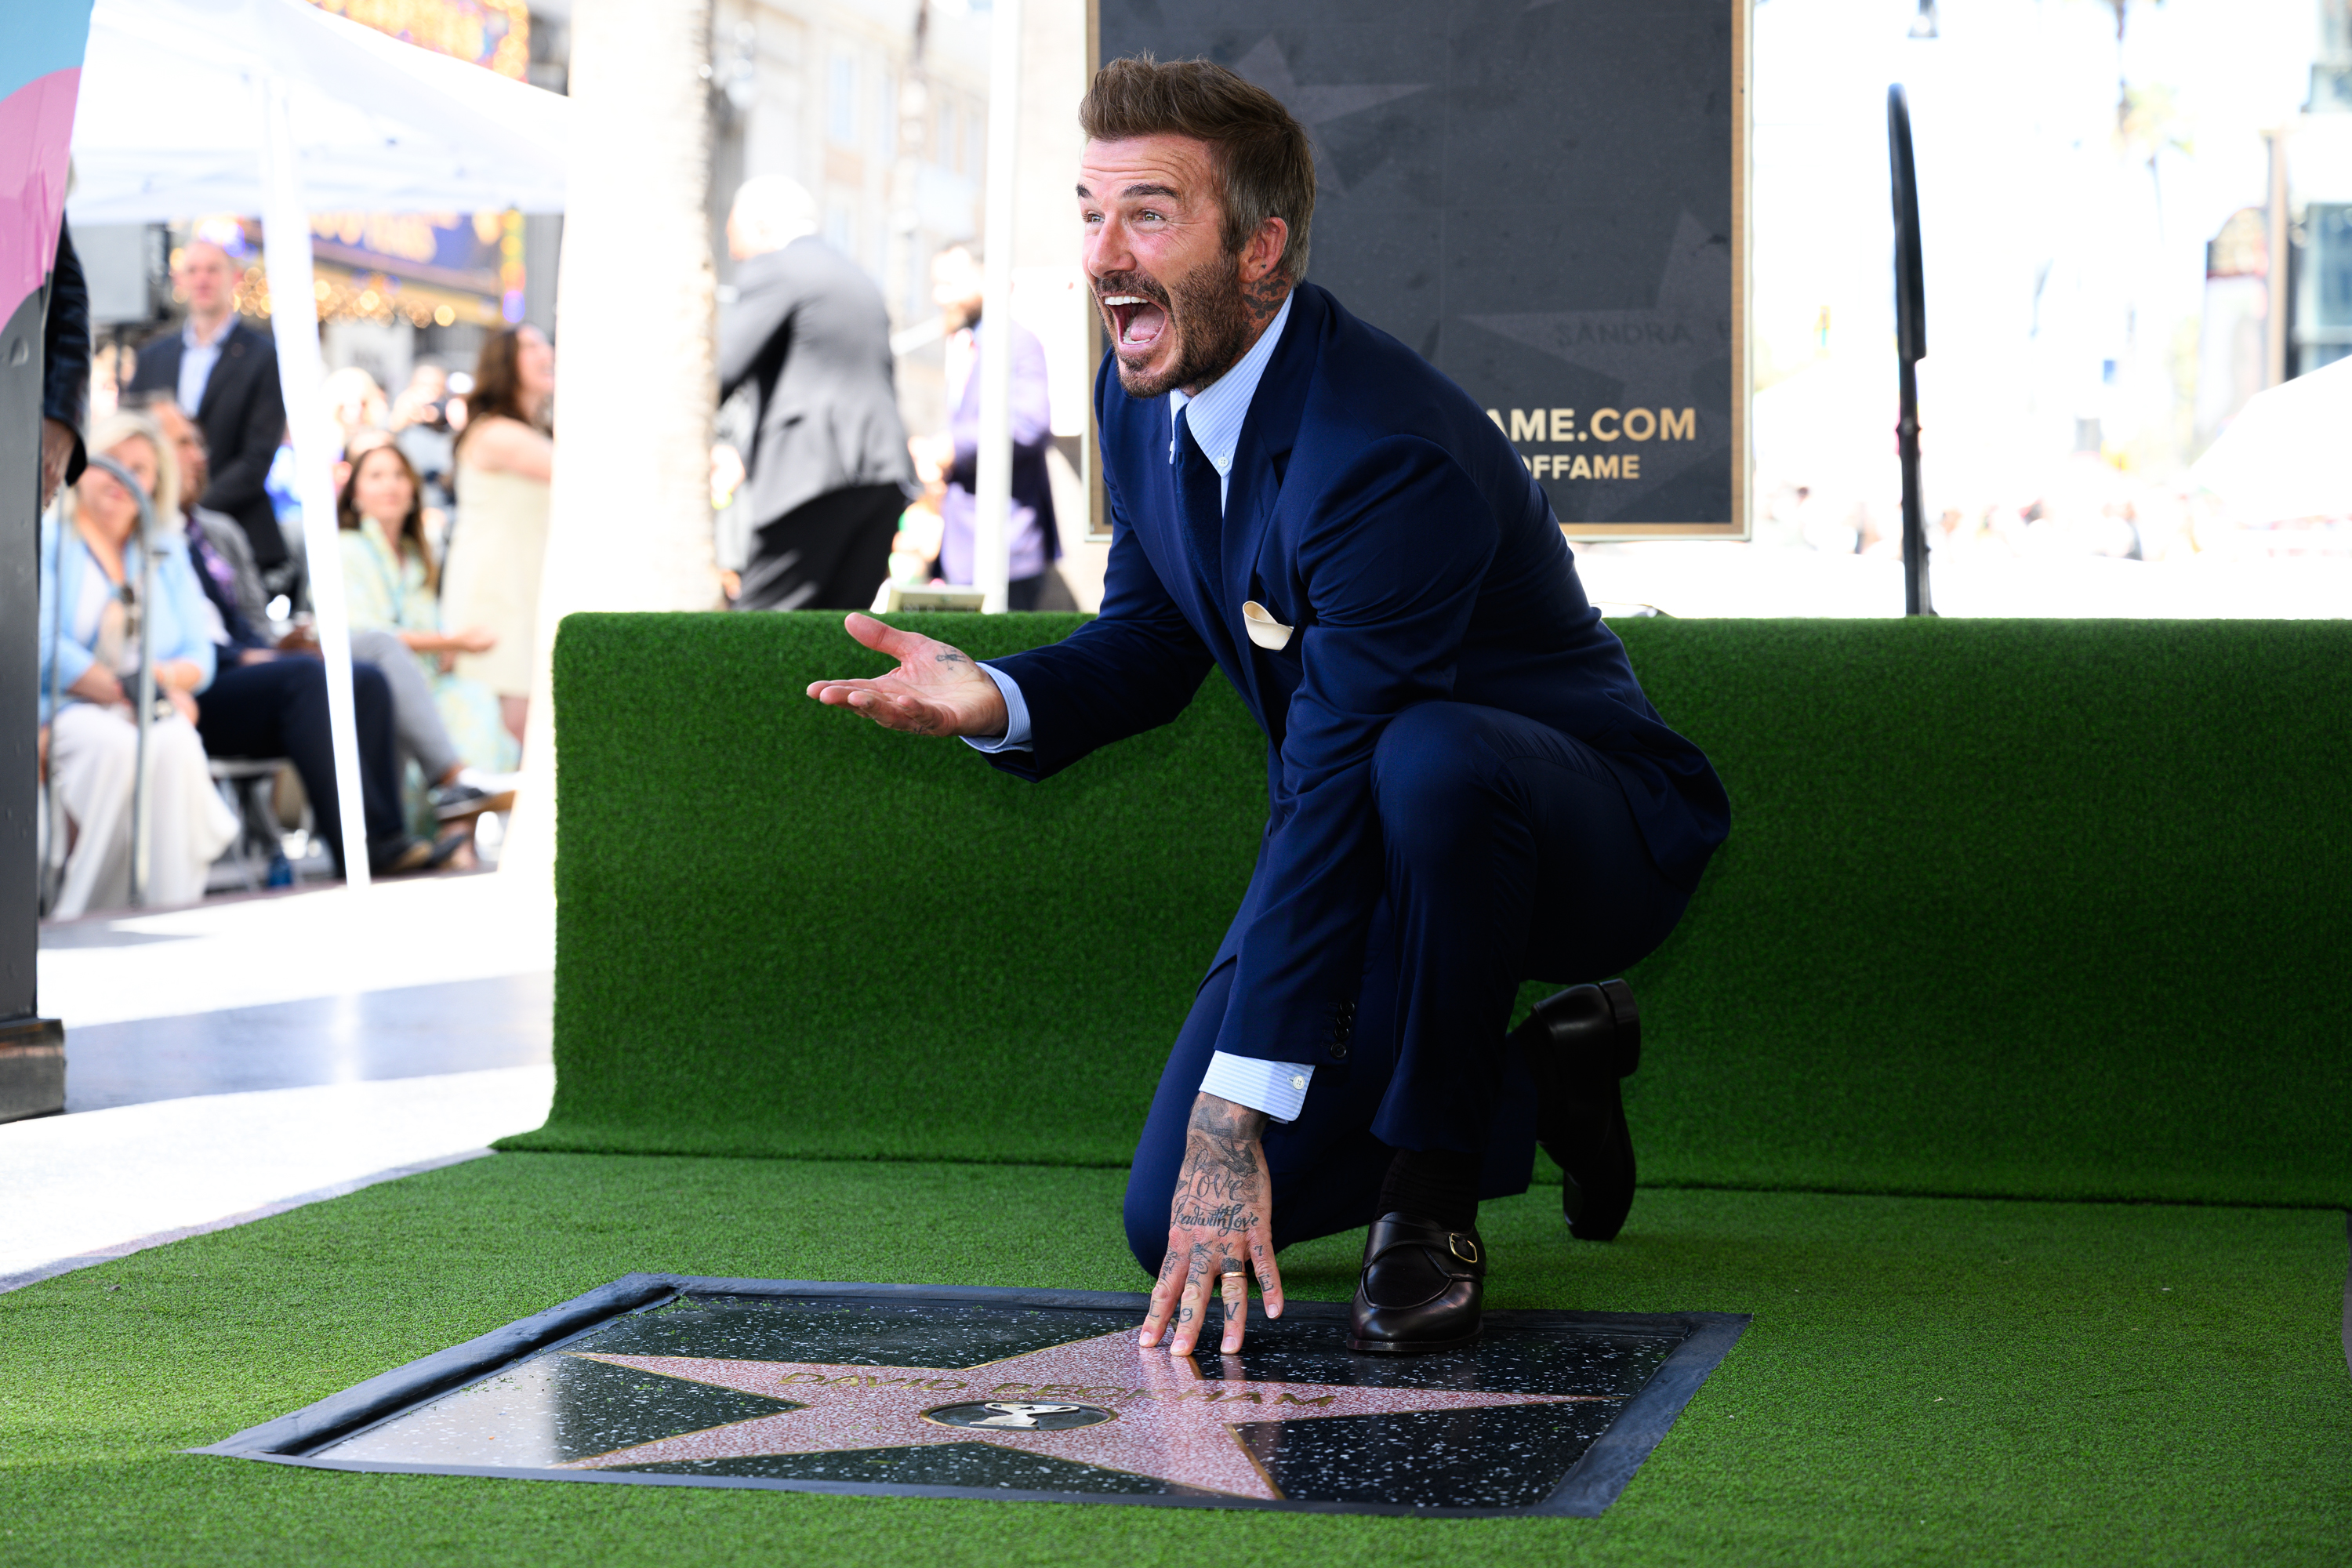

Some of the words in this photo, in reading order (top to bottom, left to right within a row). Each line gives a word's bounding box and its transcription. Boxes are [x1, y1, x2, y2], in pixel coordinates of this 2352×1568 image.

[1554, 321, 1694, 347] SANDRA
[777, 1372, 968, 1391] DAVID
[989, 1382, 1337, 1408] BECKHAM
